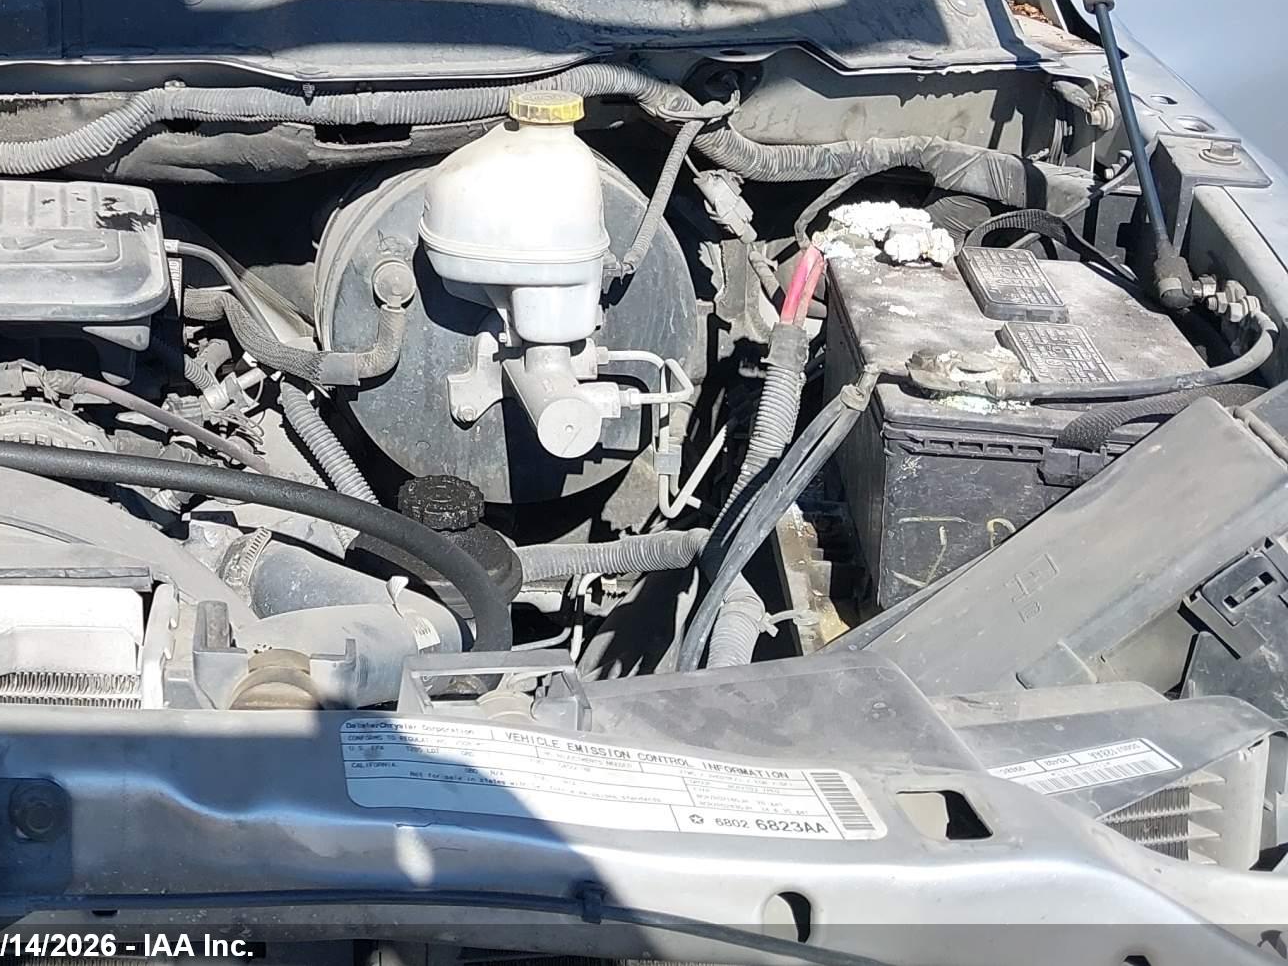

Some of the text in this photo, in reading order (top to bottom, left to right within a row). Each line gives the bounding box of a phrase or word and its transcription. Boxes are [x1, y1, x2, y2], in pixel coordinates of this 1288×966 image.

[504, 731, 561, 749] VEHICLE
[567, 742, 631, 759] EMISSION
[637, 752, 693, 767] CONTROL
[703, 761, 790, 780] INFORMATION
[715, 817, 829, 834] 6802 6823AA
